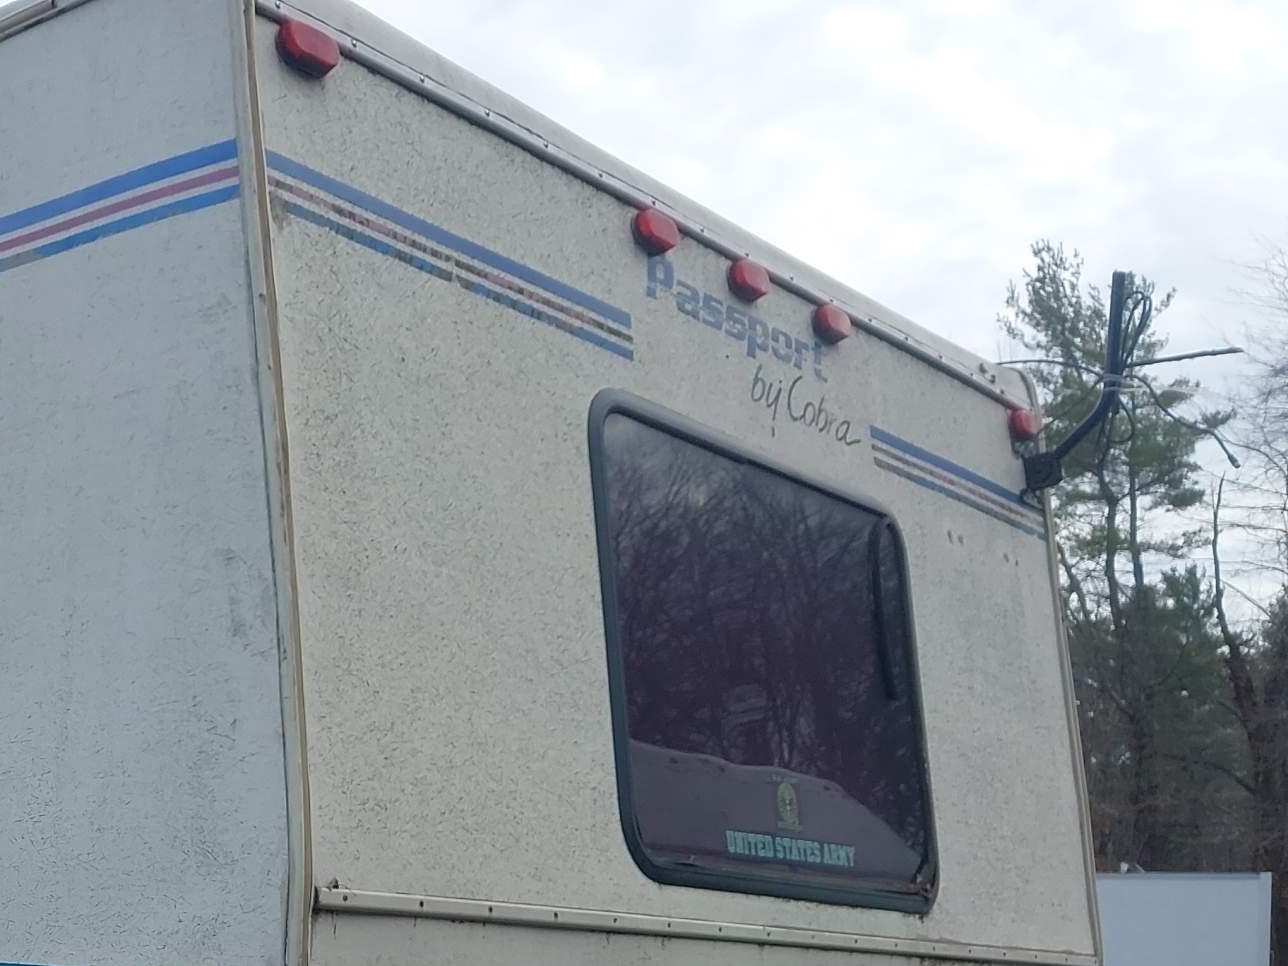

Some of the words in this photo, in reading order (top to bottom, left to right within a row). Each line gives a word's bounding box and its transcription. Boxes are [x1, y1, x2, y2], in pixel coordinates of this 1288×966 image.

[646, 255, 828, 383] Passport
[751, 364, 784, 437] by
[787, 375, 861, 446] Cobra
[726, 830, 774, 857] UNITED
[775, 837, 822, 863] STATES
[823, 843, 856, 868] ARMY
